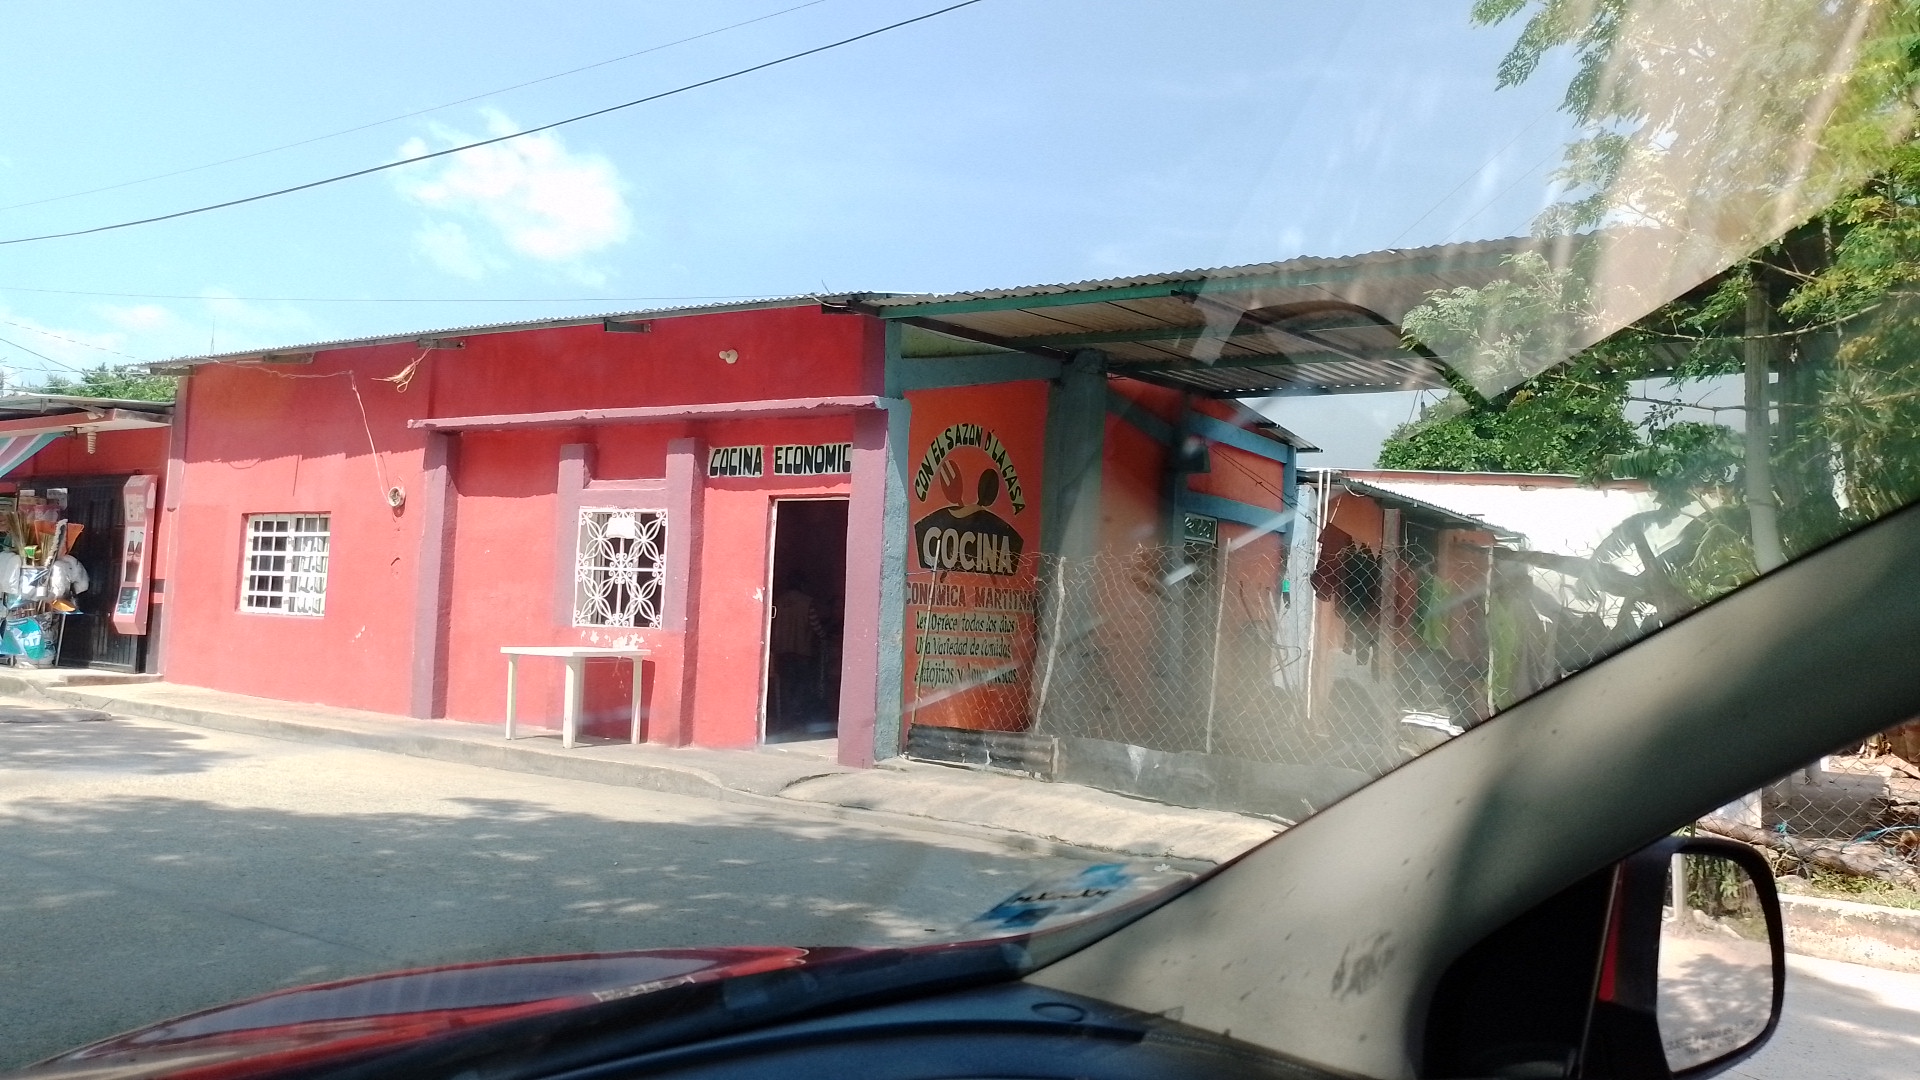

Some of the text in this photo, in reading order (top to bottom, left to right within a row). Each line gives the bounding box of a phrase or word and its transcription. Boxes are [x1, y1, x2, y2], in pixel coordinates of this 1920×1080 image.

[710, 446, 762, 476] COCINA
[915, 455, 934, 502] CON
[931, 437, 945, 466] EL
[945, 423, 983, 451] SAZON
[992, 439, 1006, 469] LA
[1002, 465, 1026, 515] CASA
[923, 526, 1013, 574] COCINA
[962, 613, 984, 632] todos
[970, 637, 980, 656] de
